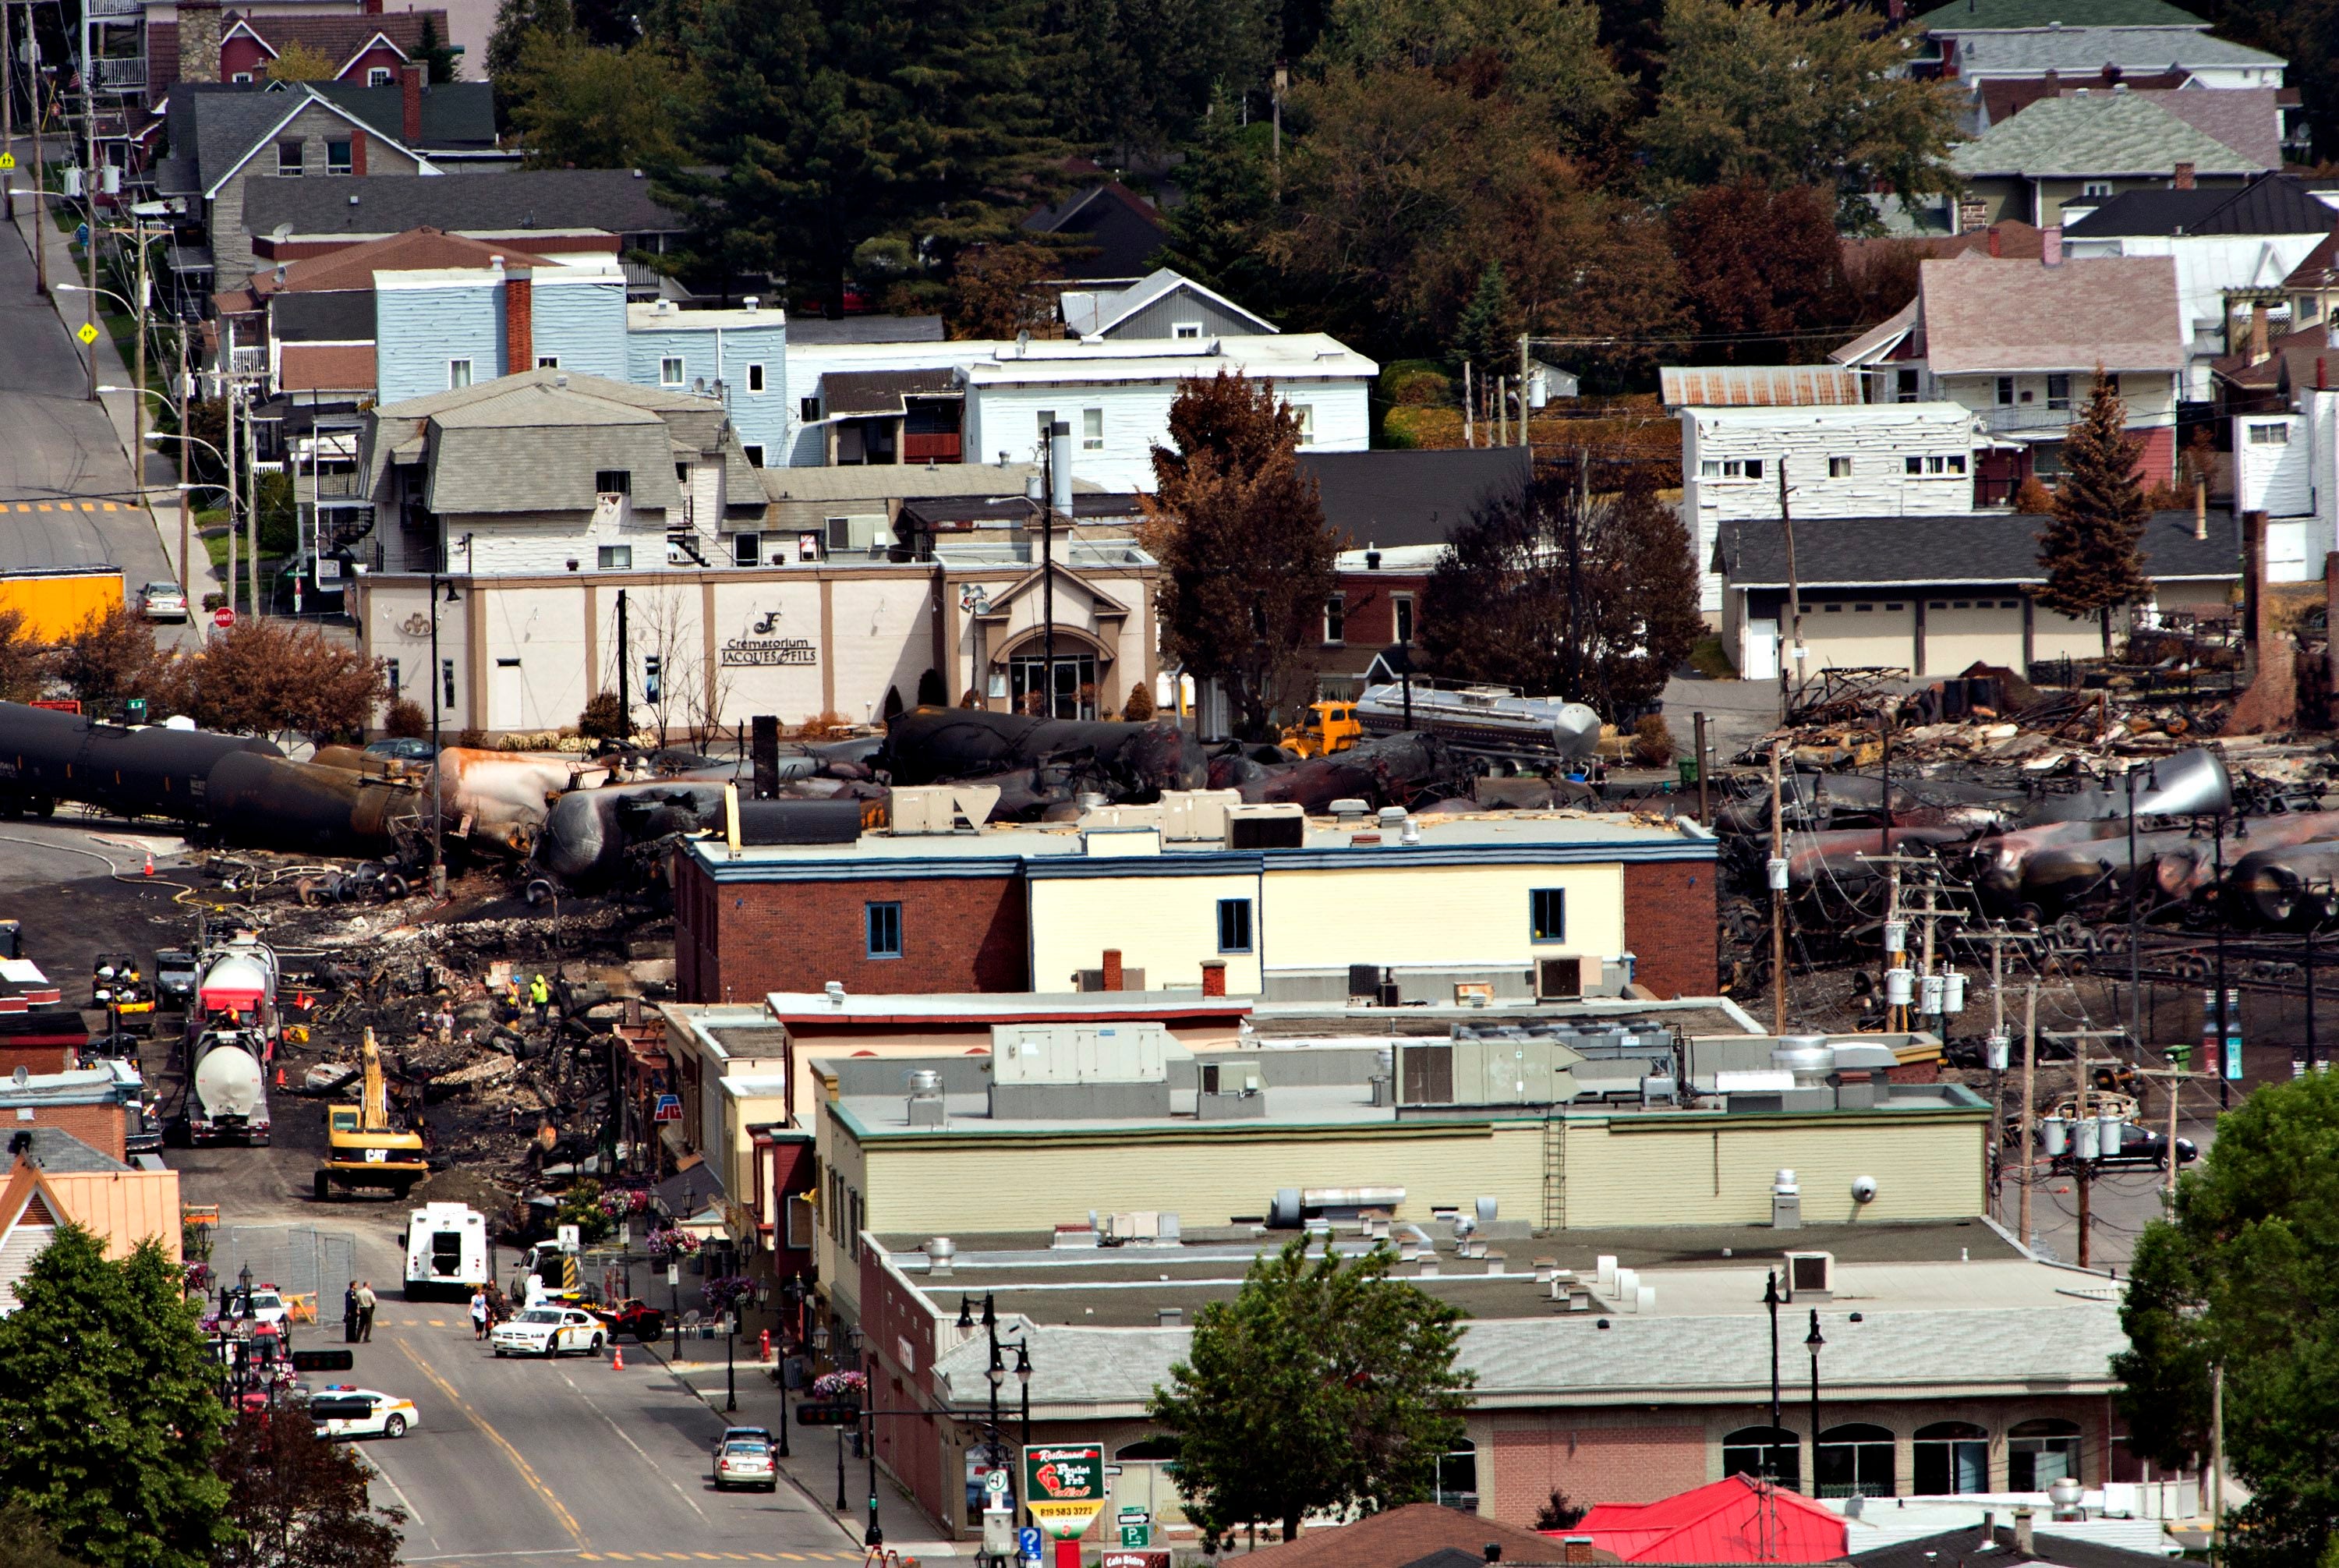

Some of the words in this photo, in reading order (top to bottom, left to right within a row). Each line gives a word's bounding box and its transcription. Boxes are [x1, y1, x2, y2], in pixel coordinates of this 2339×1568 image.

[727, 638, 809, 649] Crématorium
[722, 650, 777, 665] JACQUES
[791, 651, 816, 662] FILS
[365, 1149, 387, 1163] CAT
[1039, 1448, 1091, 1462] Restaurant
[1056, 1463, 1091, 1475] Poulet
[1064, 1474, 1085, 1485] Frit
[1040, 1508, 1054, 1517] 819
[1056, 1507, 1071, 1516] 583
[1073, 1506, 1092, 1515] 3222
[1127, 1528, 1138, 1541] P
[1123, 1555, 1145, 1567] Bistro
